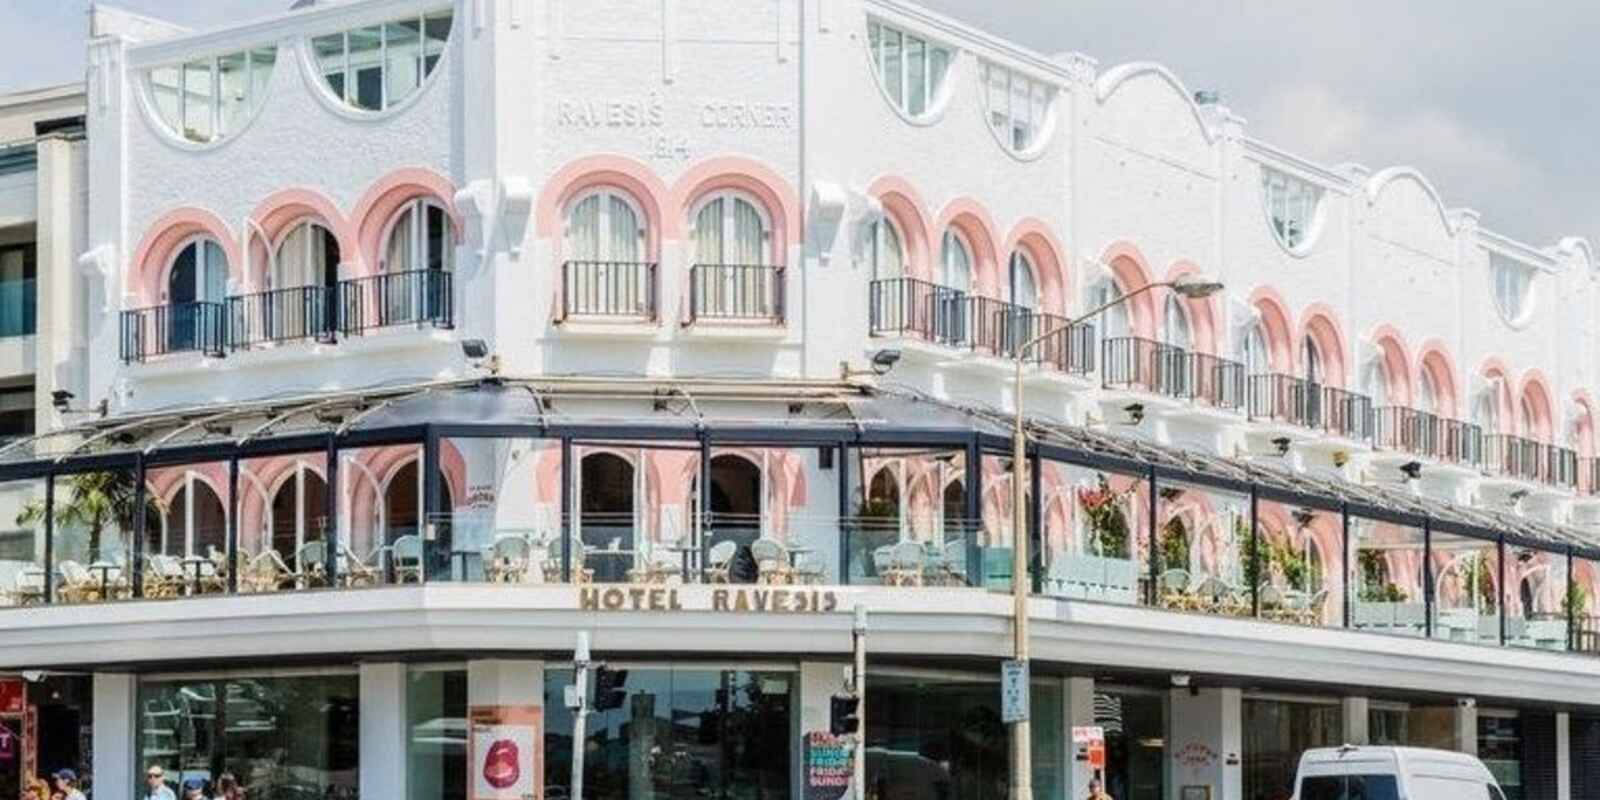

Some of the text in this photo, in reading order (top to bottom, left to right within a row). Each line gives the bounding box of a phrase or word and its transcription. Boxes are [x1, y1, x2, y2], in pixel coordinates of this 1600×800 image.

[700, 103, 791, 128] CORNER
[580, 588, 837, 612] HOTEL RAVESIS
